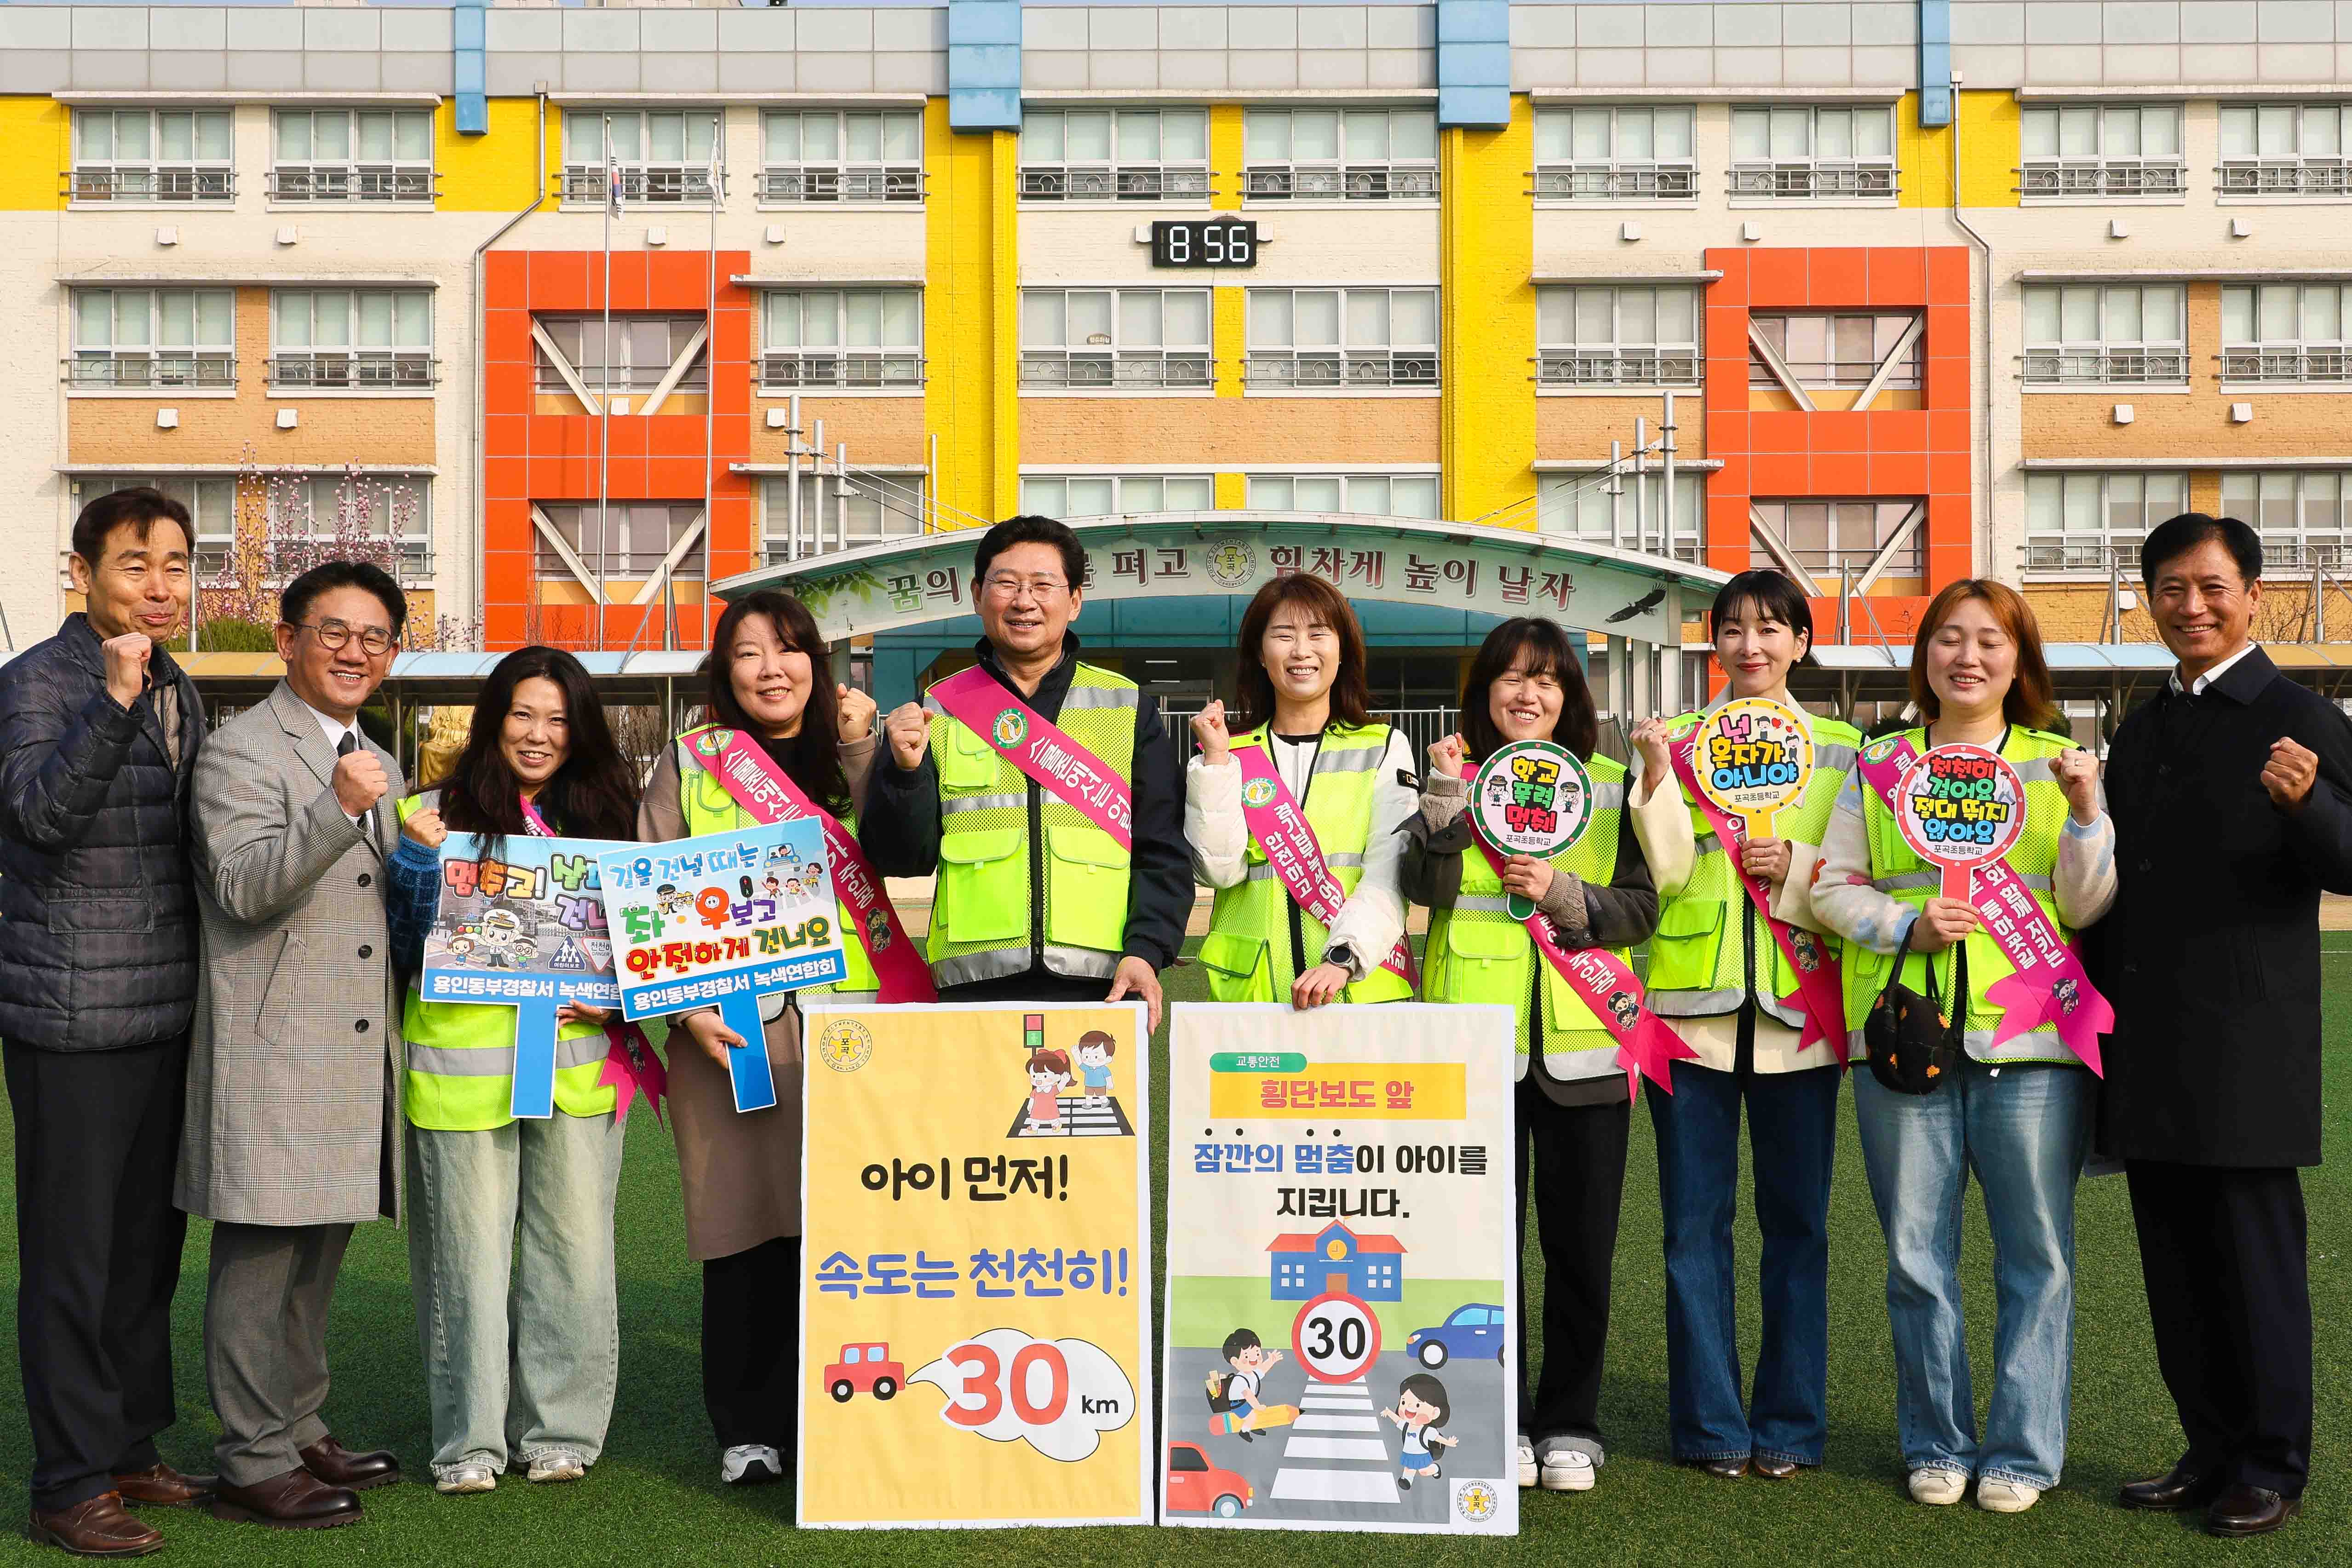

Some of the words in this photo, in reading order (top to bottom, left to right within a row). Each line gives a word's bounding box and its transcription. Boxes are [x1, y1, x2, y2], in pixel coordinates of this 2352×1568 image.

[1211, 540, 1249, 553] ELEMENTARY
[887, 568, 963, 614] 꿈의
[1111, 548, 1190, 586] 펴고
[1269, 545, 1387, 589] 힘차게
[1404, 551, 1475, 597] 높이
[1497, 569, 1575, 611] 날자
[1719, 715, 1751, 744] 넌
[1710, 736, 1784, 769] 혼자가
[1931, 757, 1996, 779] 천천히
[723, 748, 802, 822] 스쿨존에서는
[1029, 736, 1111, 808] 스쿨존에서는
[1512, 757, 1560, 784] 학교
[1713, 762, 1798, 789] 아니야
[1513, 781, 1554, 809] 폭력
[1734, 791, 1779, 802] 포곡초등학교
[1929, 776, 1995, 801] 걸어요
[1506, 805, 1556, 832] 멈춰!
[1914, 796, 1957, 819] 절대
[1962, 799, 2008, 821] 뛰지
[1274, 802, 1315, 865] 경기남부
[1506, 834, 1551, 846] 포곡초등학교
[1924, 818, 1994, 843] 않아요
[609, 856, 653, 889] 길을
[657, 853, 703, 882] 건널
[706, 842, 759, 873] 때는
[1265, 831, 1313, 898] 안전하고
[1934, 844, 1982, 855] 포곡초등학교
[445, 857, 548, 899] 멈추고!
[838, 861, 875, 909] 주인공
[1980, 897, 2038, 971] 등하굣길
[1999, 885, 2033, 919] 함께
[2025, 917, 2065, 969] 지키는
[626, 936, 750, 981] 안전하게
[751, 916, 831, 955] 건너요
[434, 975, 554, 998] 용인동부경찰서
[633, 976, 750, 1011] 용인동부경찰서
[754, 958, 837, 987] 녹색연합회
[1568, 952, 1617, 995] 주인공
[1236, 1056, 1280, 1068] 교통안전
[1261, 1080, 1376, 1109] 횡단보도
[1385, 1080, 1414, 1109] 앞
[1194, 1143, 1283, 1173] 잠깐의
[1294, 1144, 1383, 1173] 멈춤이
[1395, 1145, 1488, 1175] 아이를
[861, 1157, 950, 1201] 아이
[964, 1154, 1067, 1201] 먼저!
[1277, 1188, 1410, 1218] 지킵니다.
[815, 1250, 959, 1300] 속도는
[969, 1247, 1127, 1297] 천천히!
[1308, 1316, 1365, 1360] 30
[944, 1344, 1068, 1426] 30
[1082, 1395, 1119, 1414] km
